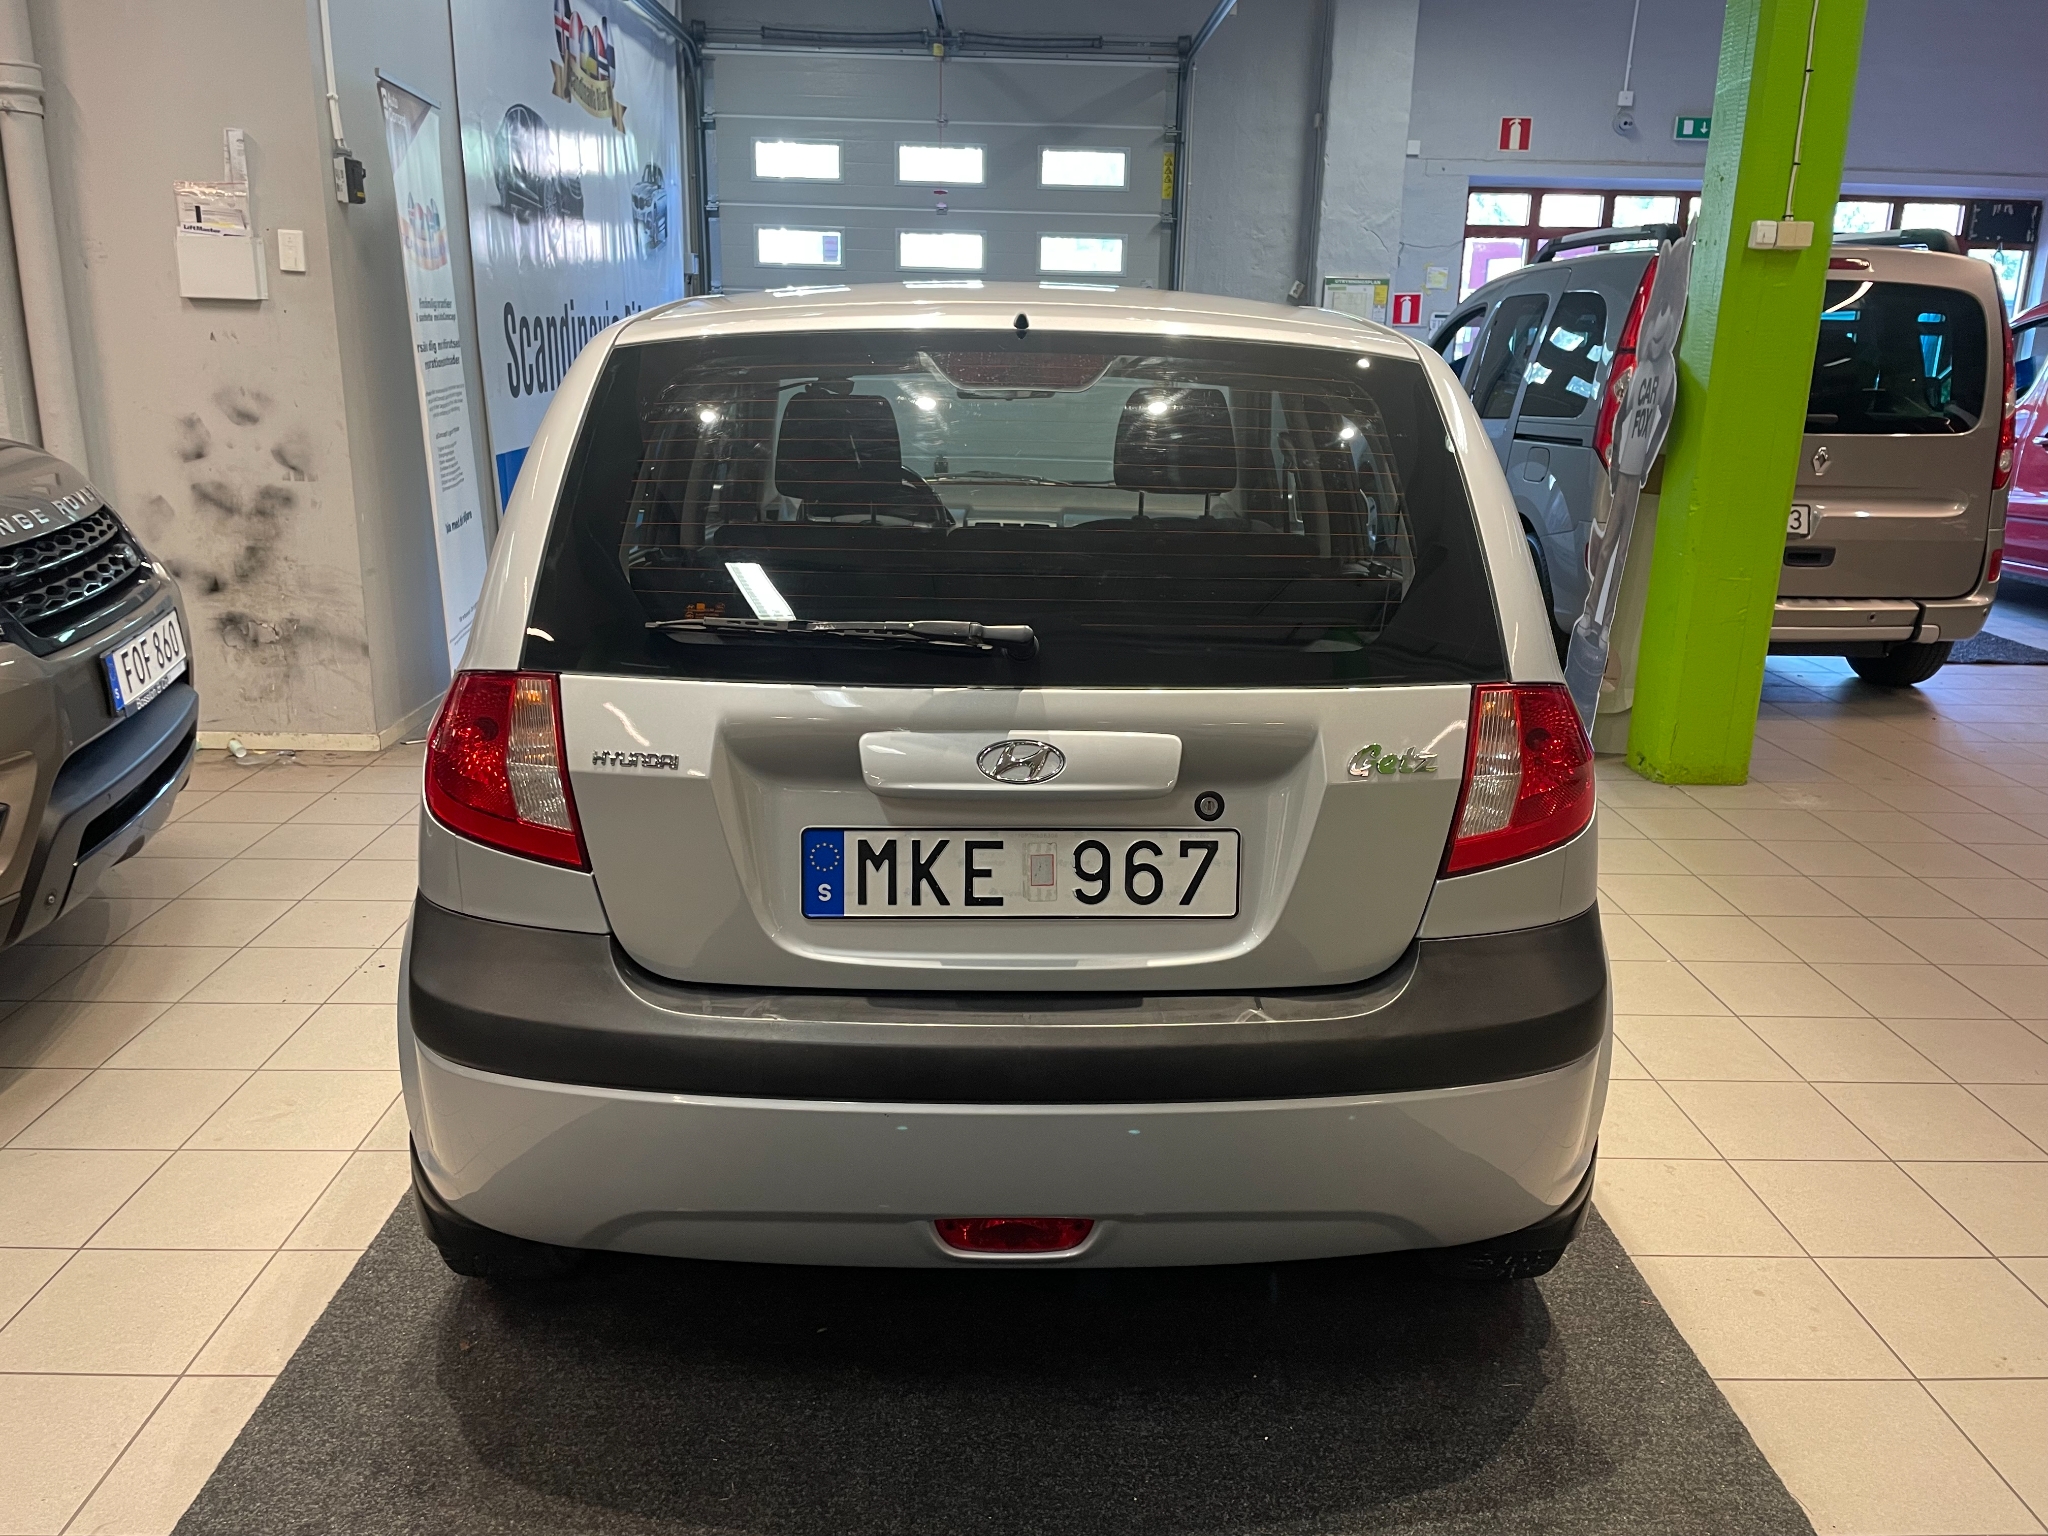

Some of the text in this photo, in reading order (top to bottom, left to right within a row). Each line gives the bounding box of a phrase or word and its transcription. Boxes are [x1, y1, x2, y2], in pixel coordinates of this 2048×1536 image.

[1638, 375, 1660, 406] CAR
[1631, 408, 1653, 439] FOX
[121, 620, 179, 693] FOF 860
[592, 750, 679, 770] HYUNDAI
[1348, 743, 1437, 777] Getz
[857, 839, 1219, 906] MKE 967
[818, 883, 832, 901] S
